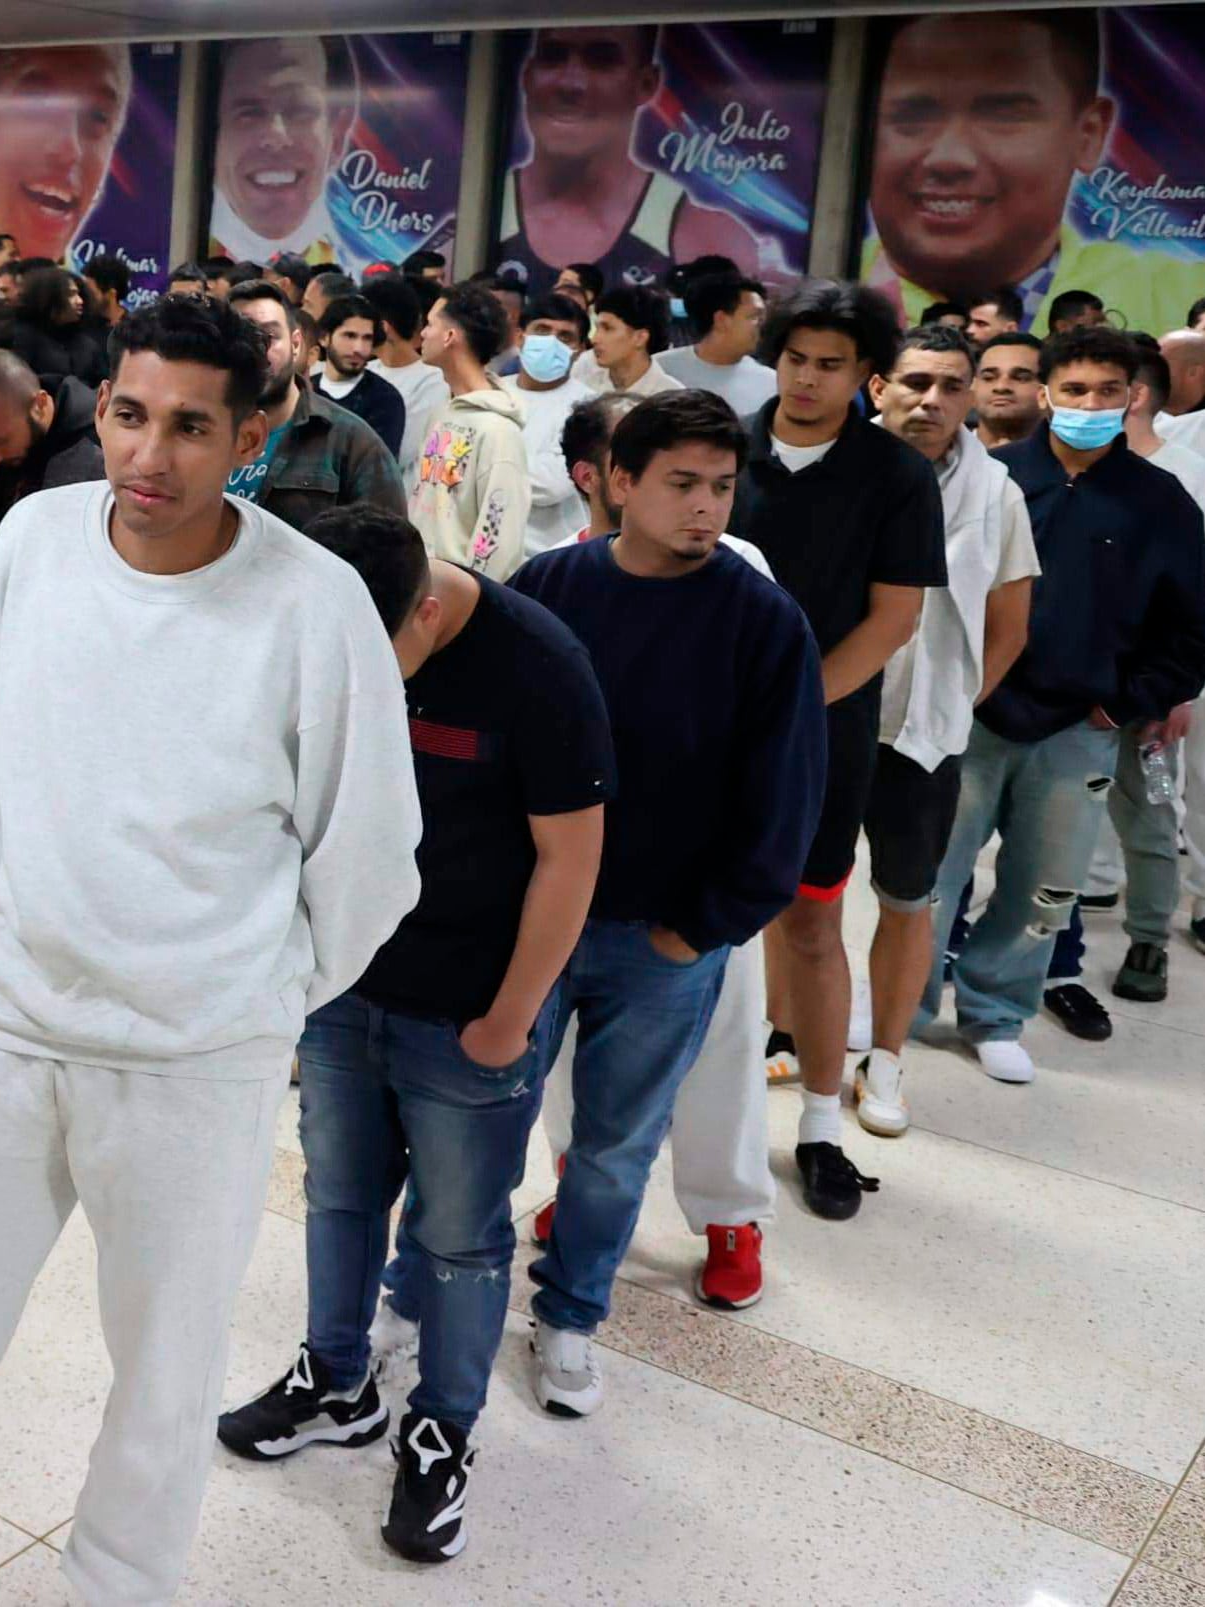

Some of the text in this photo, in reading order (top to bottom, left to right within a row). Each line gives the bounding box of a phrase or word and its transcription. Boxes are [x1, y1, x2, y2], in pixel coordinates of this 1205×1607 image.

[718, 101, 791, 145] Julio
[341, 149, 433, 190] Daniel
[657, 130, 787, 186] Mayora
[351, 190, 434, 233] Dhers
